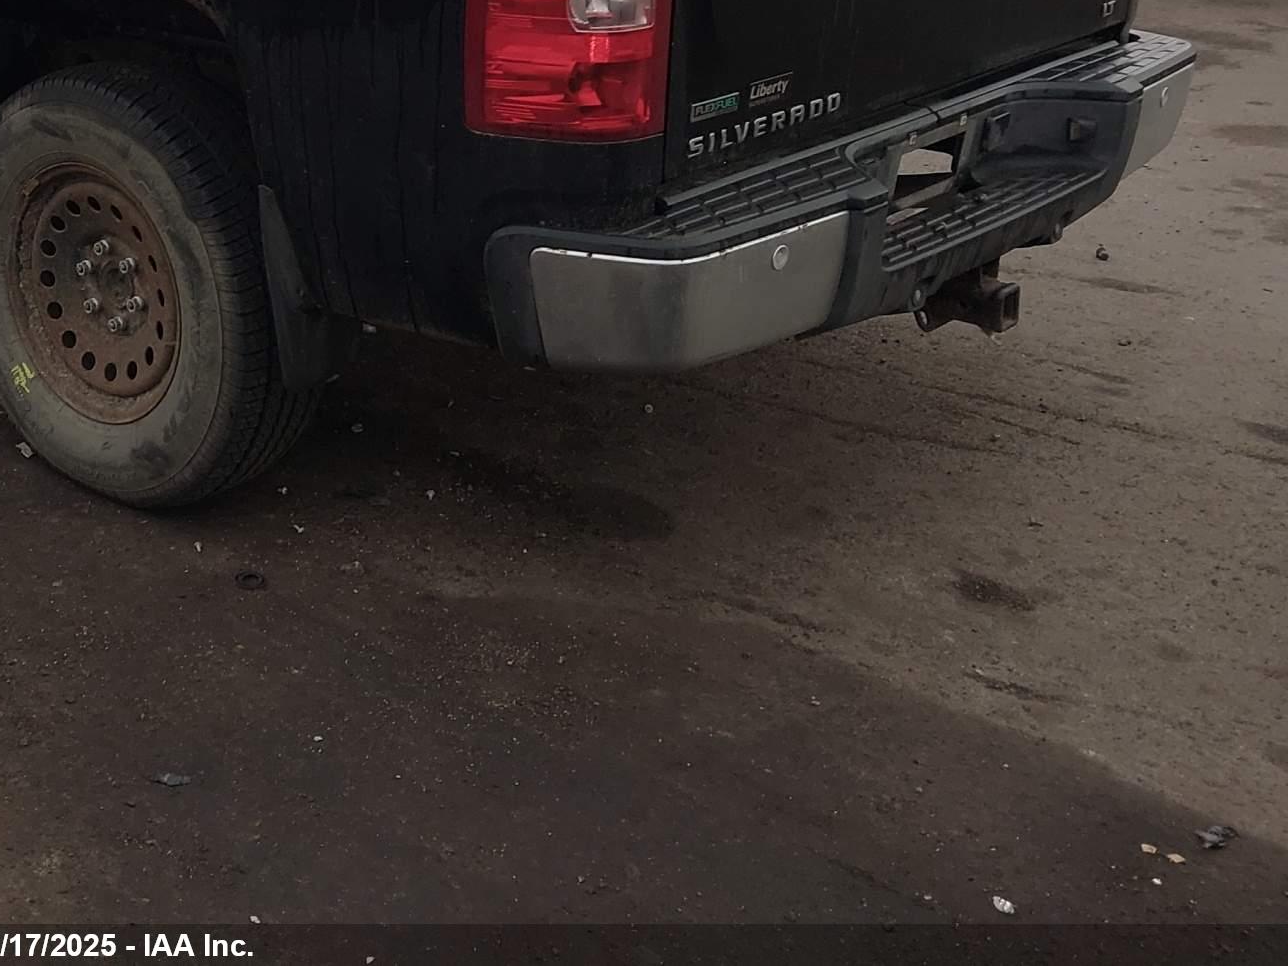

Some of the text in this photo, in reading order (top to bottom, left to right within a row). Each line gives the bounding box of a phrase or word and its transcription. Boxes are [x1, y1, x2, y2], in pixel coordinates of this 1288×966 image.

[1103, 0, 1117, 18] LT
[749, 80, 789, 100] Liberty
[687, 92, 842, 158] SILVERADO
